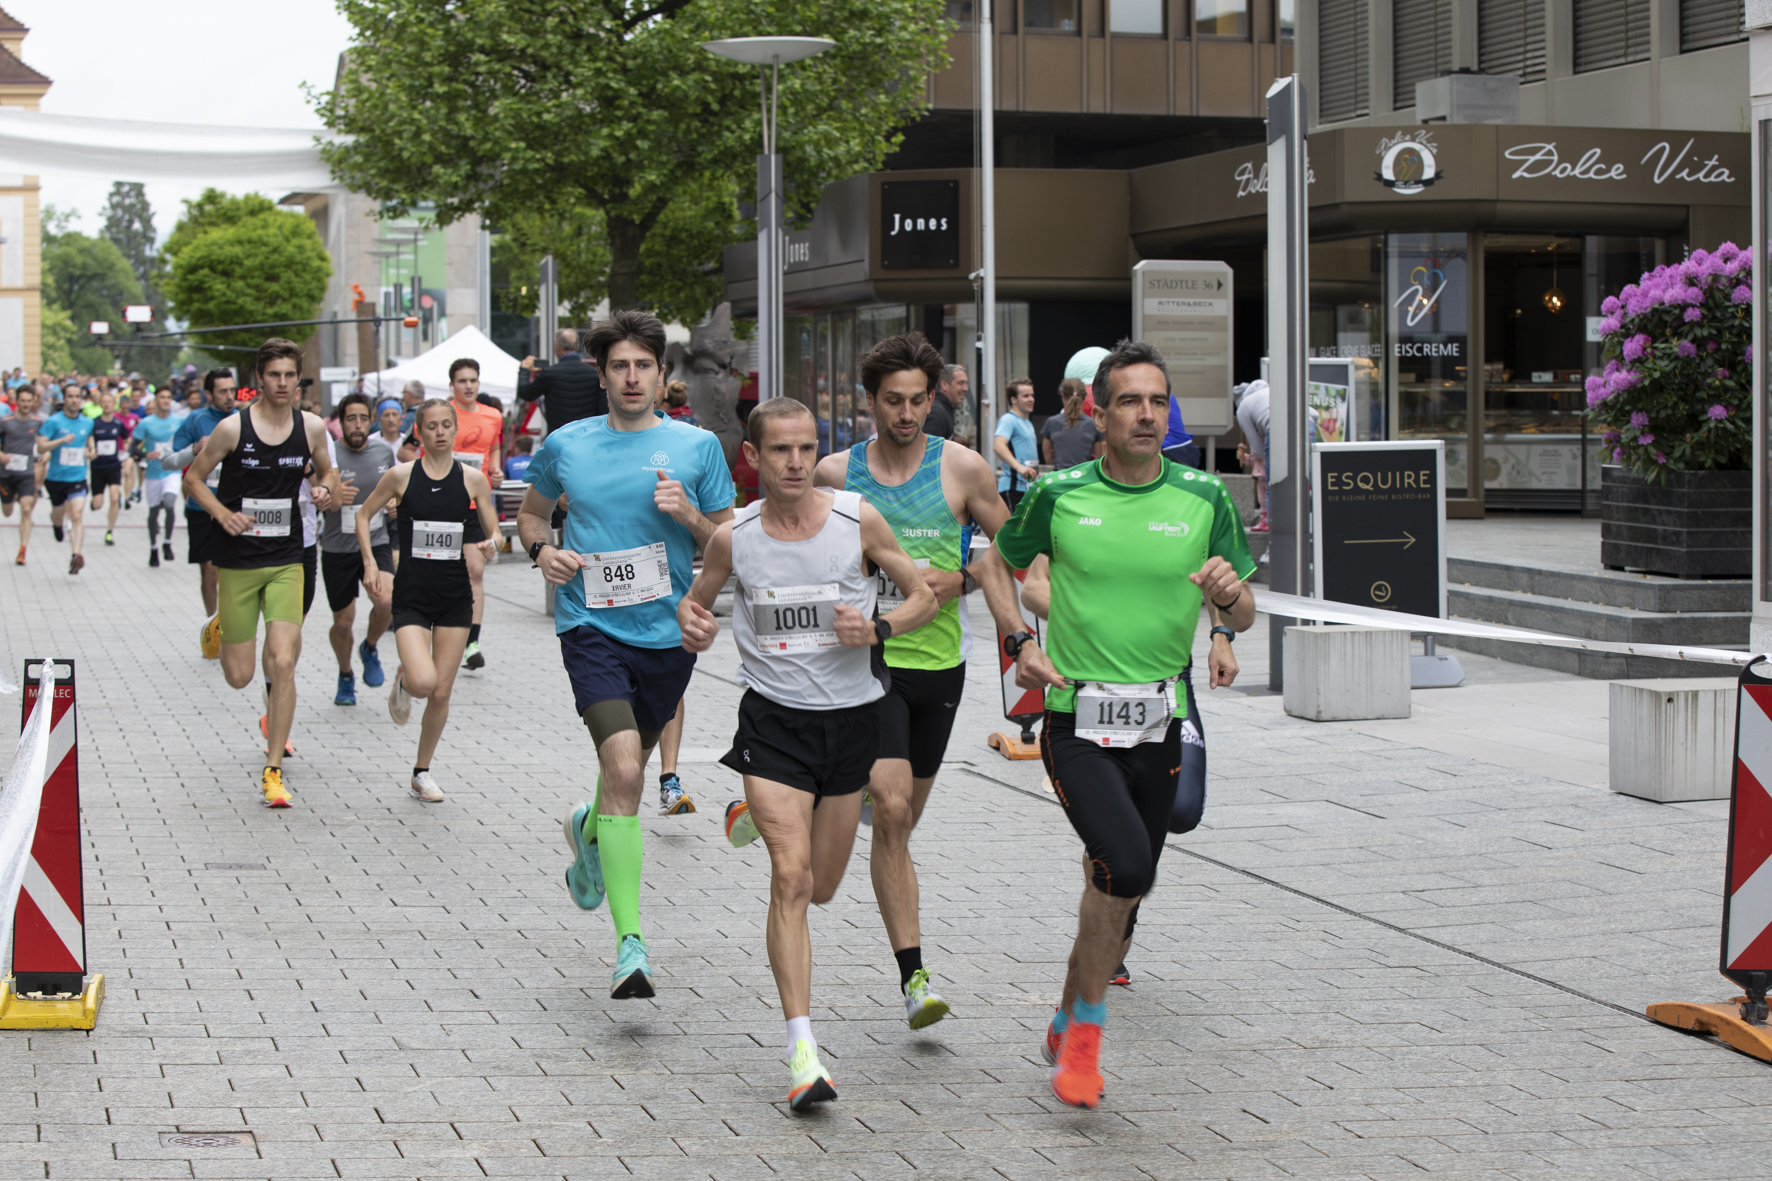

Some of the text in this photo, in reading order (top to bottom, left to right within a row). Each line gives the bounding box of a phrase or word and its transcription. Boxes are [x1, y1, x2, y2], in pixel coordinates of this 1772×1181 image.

[1504, 137, 1736, 185] Dolce Vita
[890, 213, 948, 236] Jones
[784, 236, 810, 270] Jones
[1148, 278, 1214, 290] STÄDTLE 36
[1394, 343, 1460, 356] EISCREME
[1328, 470, 1431, 490] ESQUIRE
[254, 510, 282, 524] 1008
[1078, 516, 1102, 526] JAKO
[425, 533, 452, 548] 1140
[909, 528, 940, 538] USTER
[602, 564, 636, 583] 848
[612, 584, 632, 592] XAVIER
[774, 605, 820, 631] 1001
[1098, 700, 1146, 726] 1143
